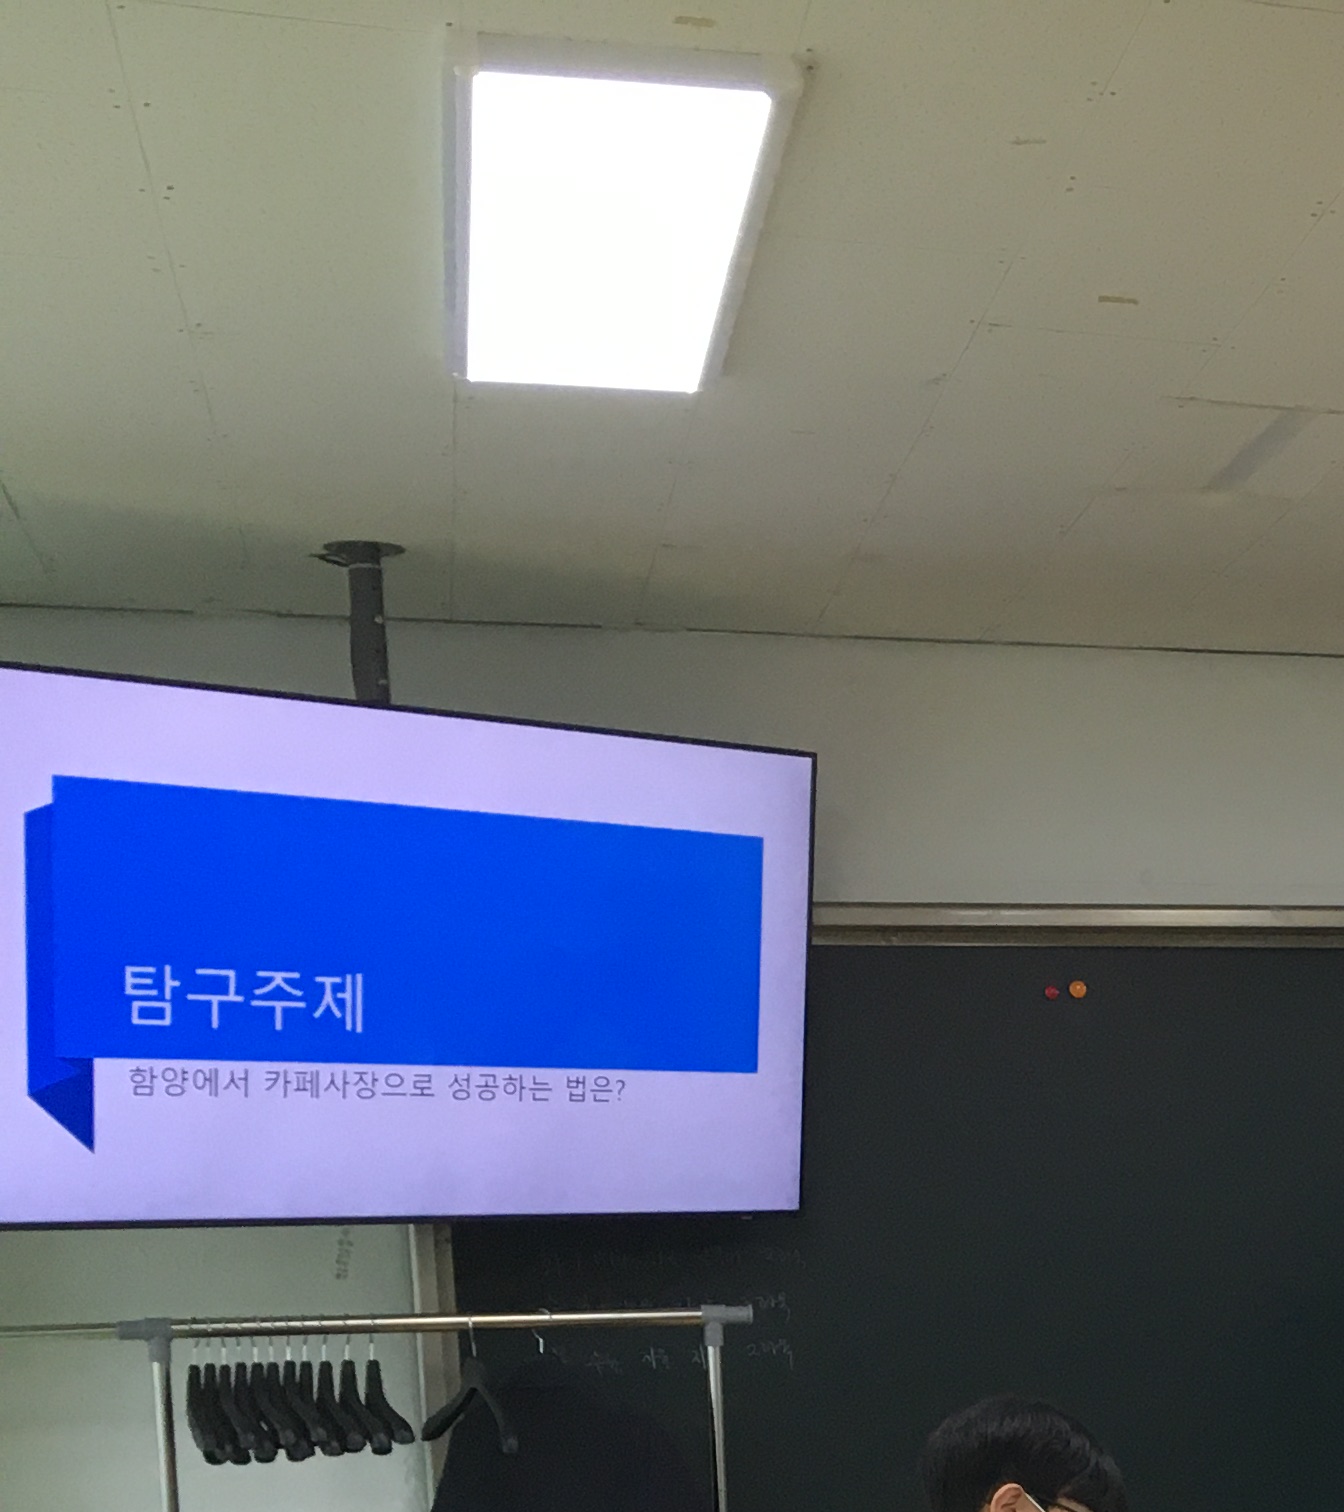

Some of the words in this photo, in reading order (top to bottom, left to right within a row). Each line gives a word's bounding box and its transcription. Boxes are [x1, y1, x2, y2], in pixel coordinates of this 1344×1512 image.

[122, 963, 366, 1036] 탐구주제
[127, 1064, 251, 1101] 함양에서
[263, 1067, 437, 1103] 카페사장으로
[447, 1073, 552, 1105] 성공하는
[565, 1075, 627, 1105] 법은?
